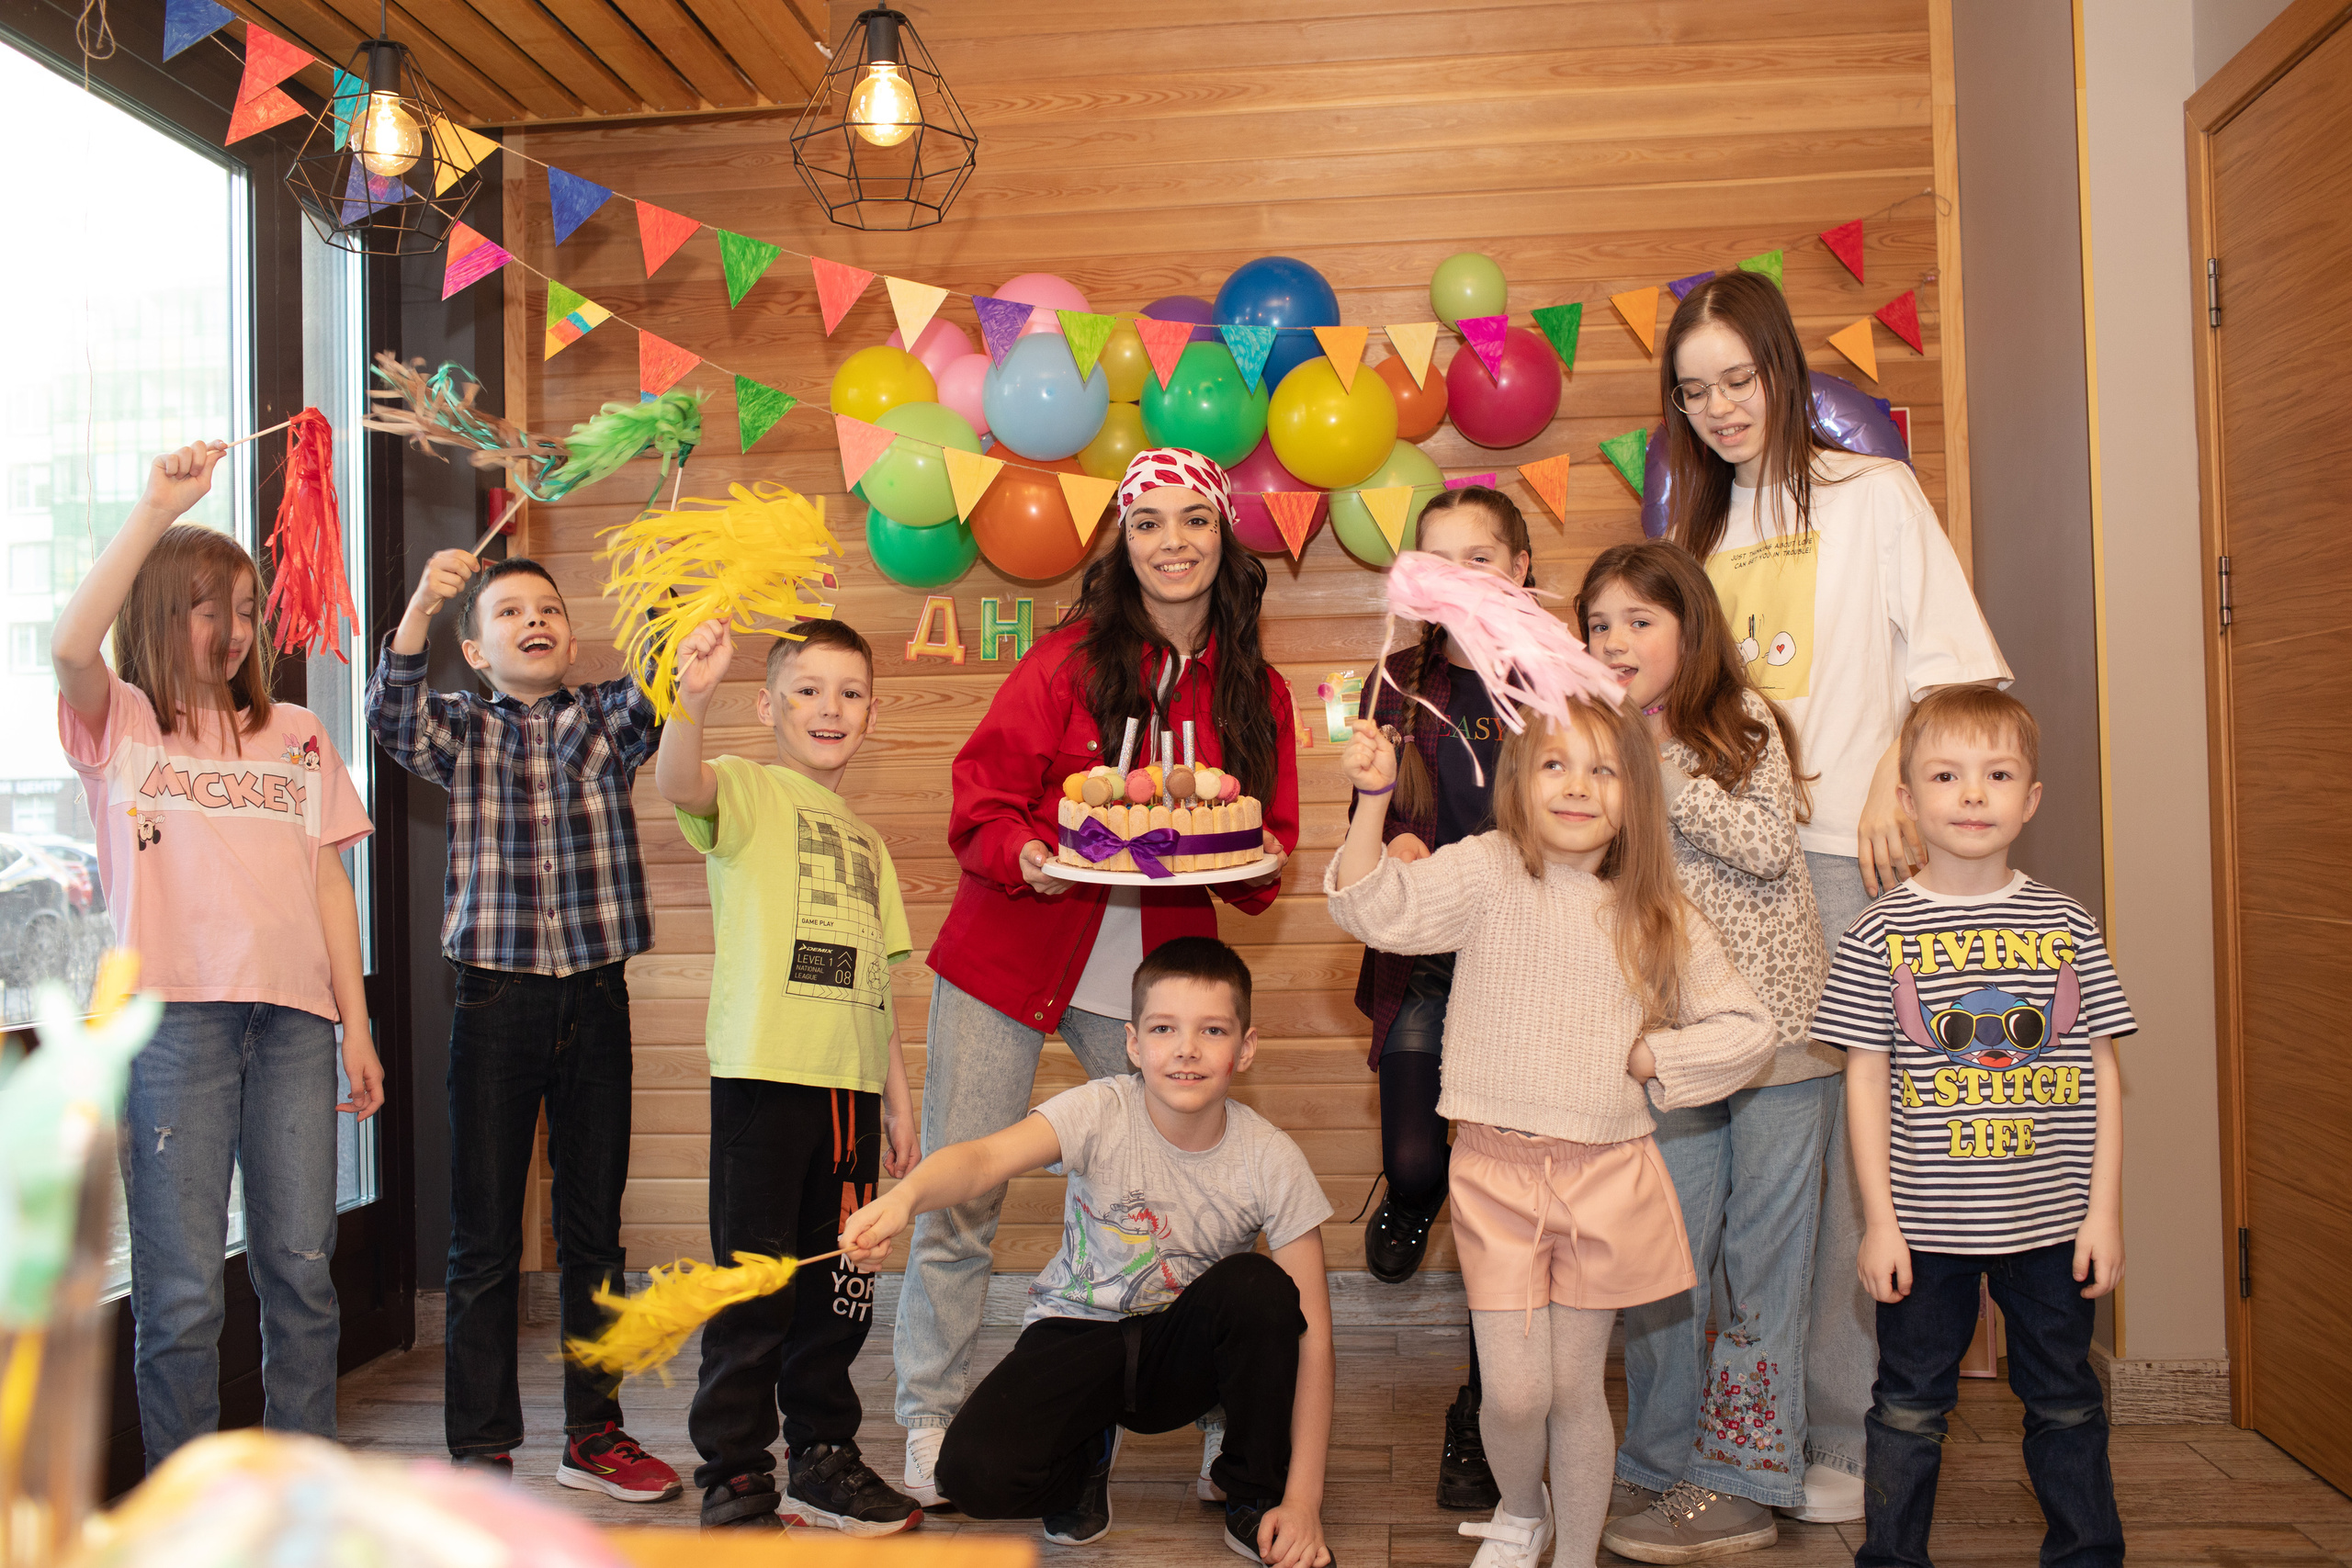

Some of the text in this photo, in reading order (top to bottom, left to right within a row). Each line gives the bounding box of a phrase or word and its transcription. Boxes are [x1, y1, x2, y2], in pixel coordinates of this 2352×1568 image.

[1730, 553, 1747, 561] JUST
[1774, 540, 1795, 549] ABOUT
[1758, 551, 1771, 560] YOU
[140, 761, 307, 816] MICKEY
[801, 918, 819, 926] GAME
[806, 946, 834, 954] DEMIX
[1885, 929, 2075, 976] LIVING
[797, 953, 833, 967] LEVEL 1
[794, 972, 818, 981] LEAGUE
[796, 964, 825, 974] NATIONAL
[834, 969, 852, 986] 08
[1901, 1066, 2081, 1108] A STITCH
[1946, 1118, 2036, 1157] LIFE
[832, 1297, 873, 1322] CIT
